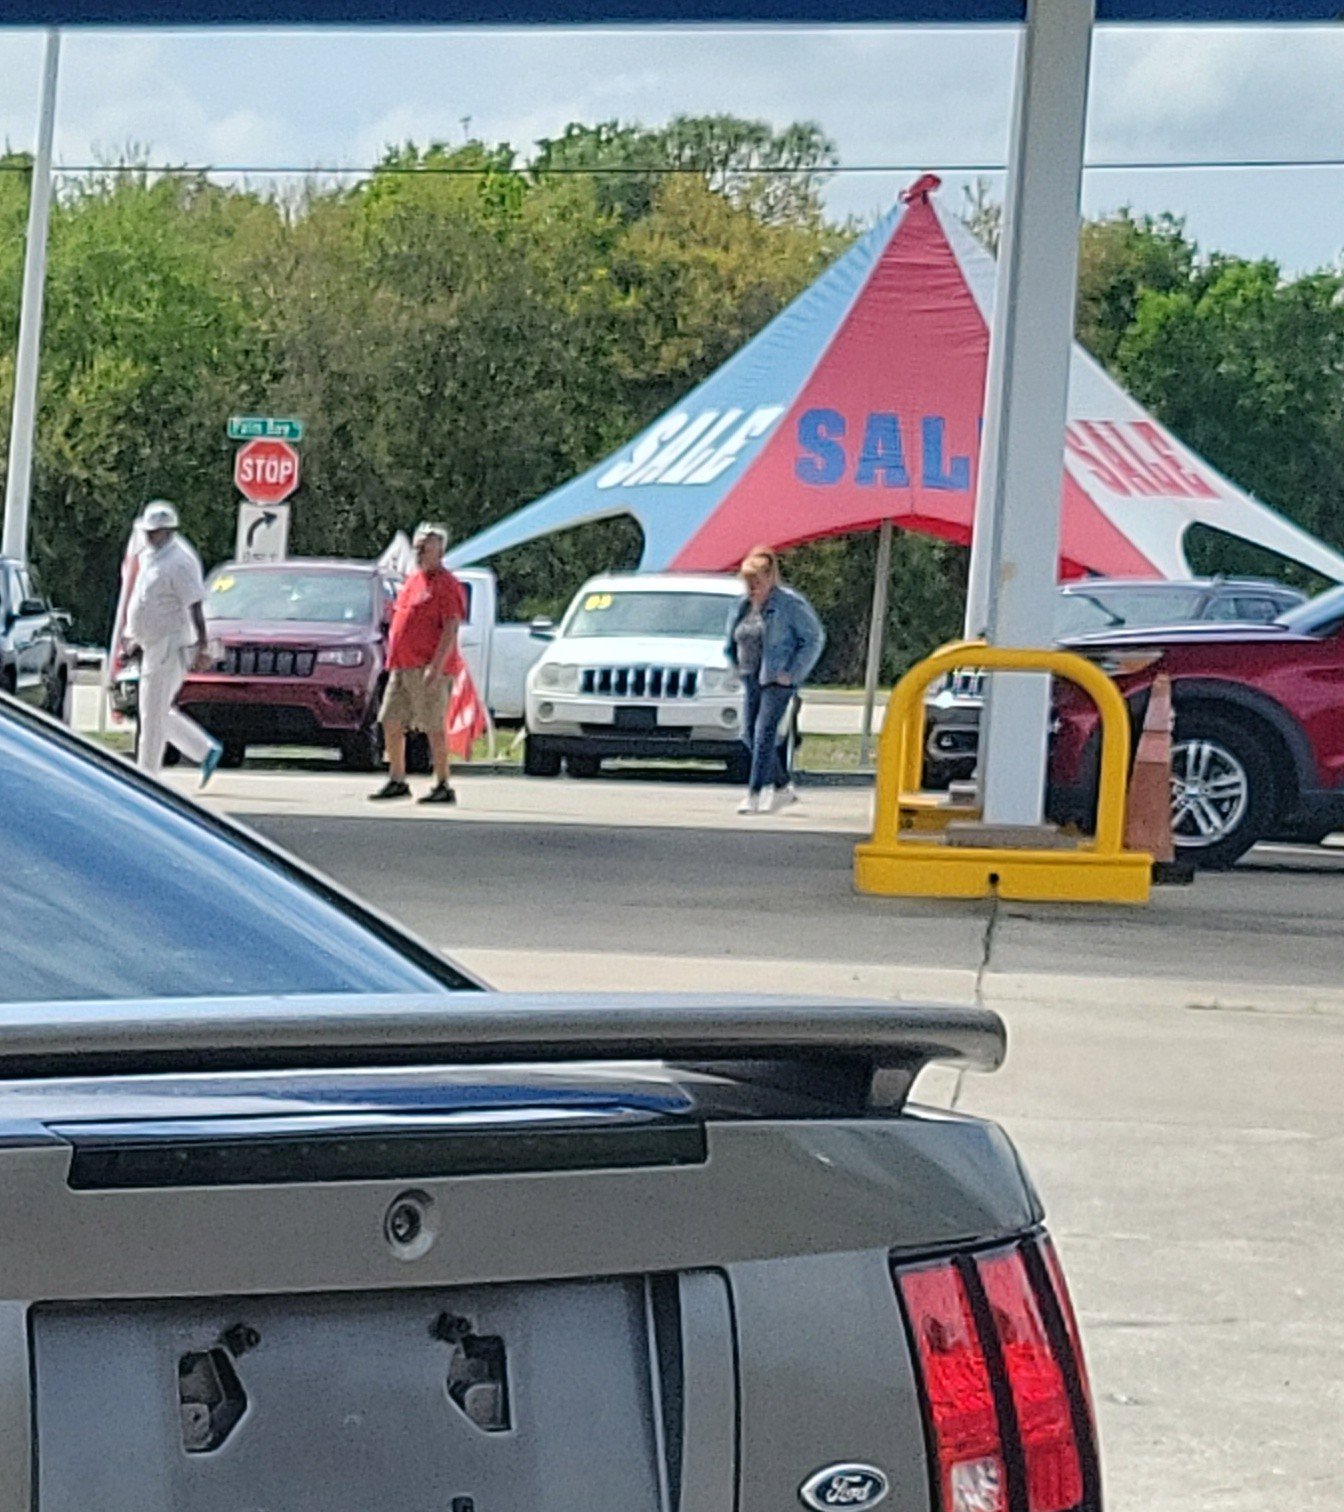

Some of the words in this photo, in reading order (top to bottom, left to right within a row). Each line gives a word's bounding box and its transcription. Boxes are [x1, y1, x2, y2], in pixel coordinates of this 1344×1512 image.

[239, 458, 293, 485] STOP
[595, 405, 785, 491] SALE
[793, 407, 984, 493] SAL
[825, 1475, 874, 1504] Ford
